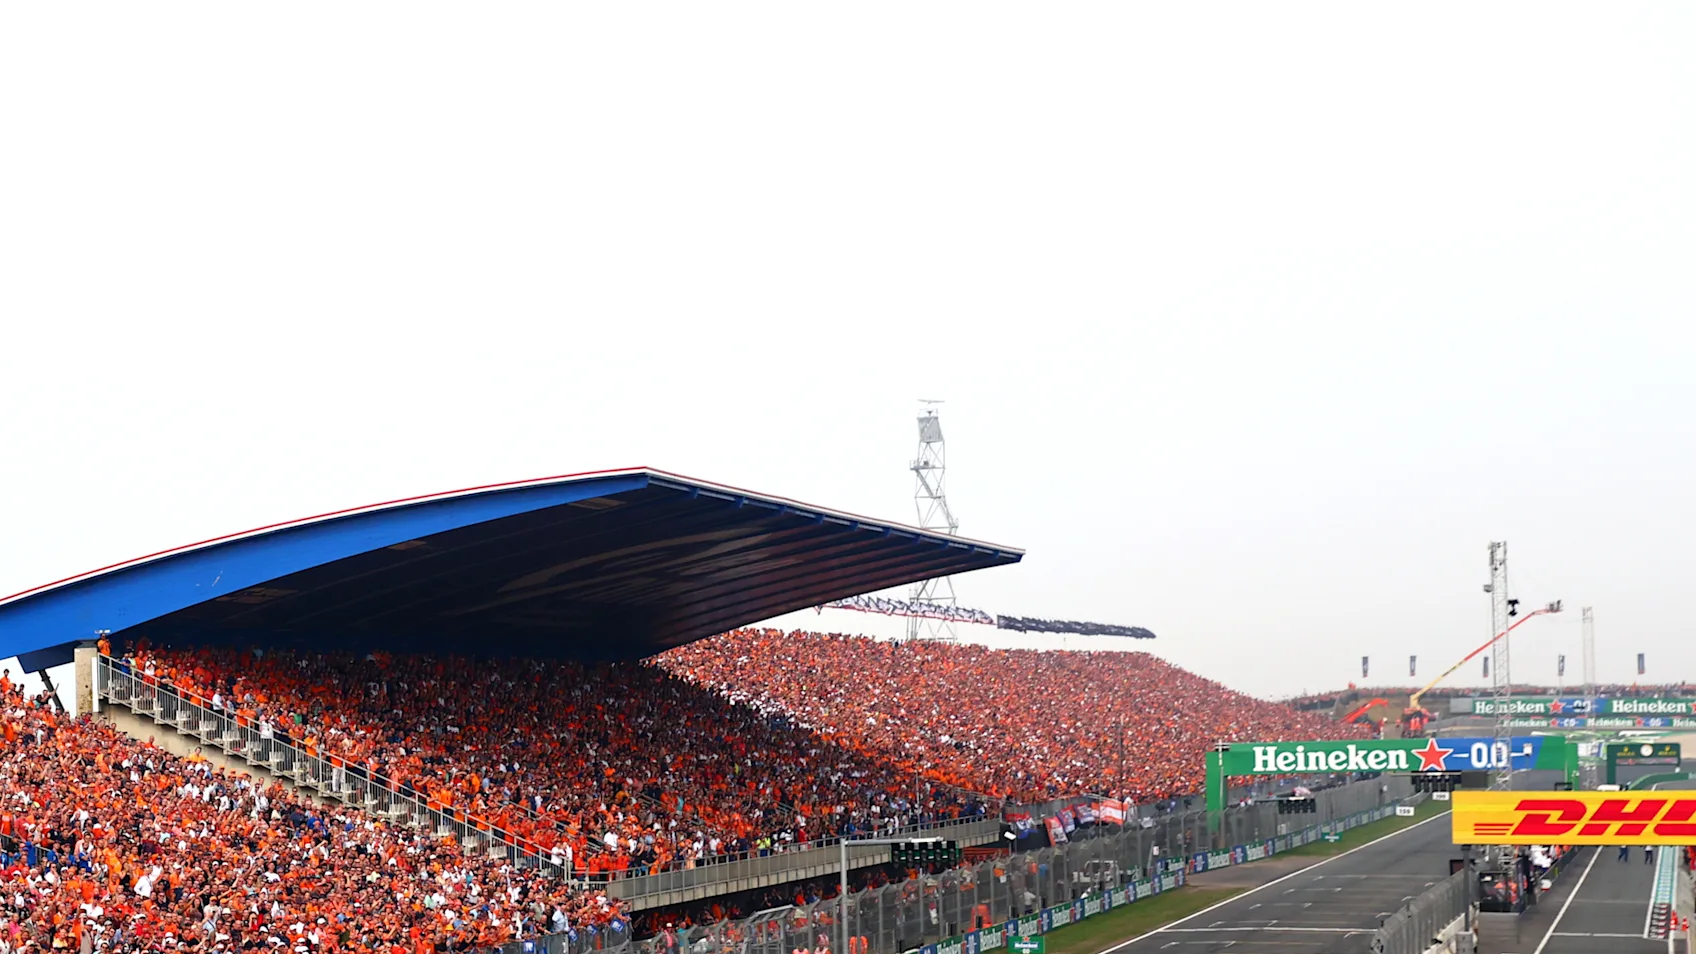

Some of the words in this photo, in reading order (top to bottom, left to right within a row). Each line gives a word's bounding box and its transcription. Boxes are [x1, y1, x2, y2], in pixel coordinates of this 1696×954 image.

[1612, 700, 1687, 713] Heineken
[1252, 745, 1410, 772] Heineken
[1471, 742, 1507, 769] 0.0
[1510, 799, 1696, 836] DHL
